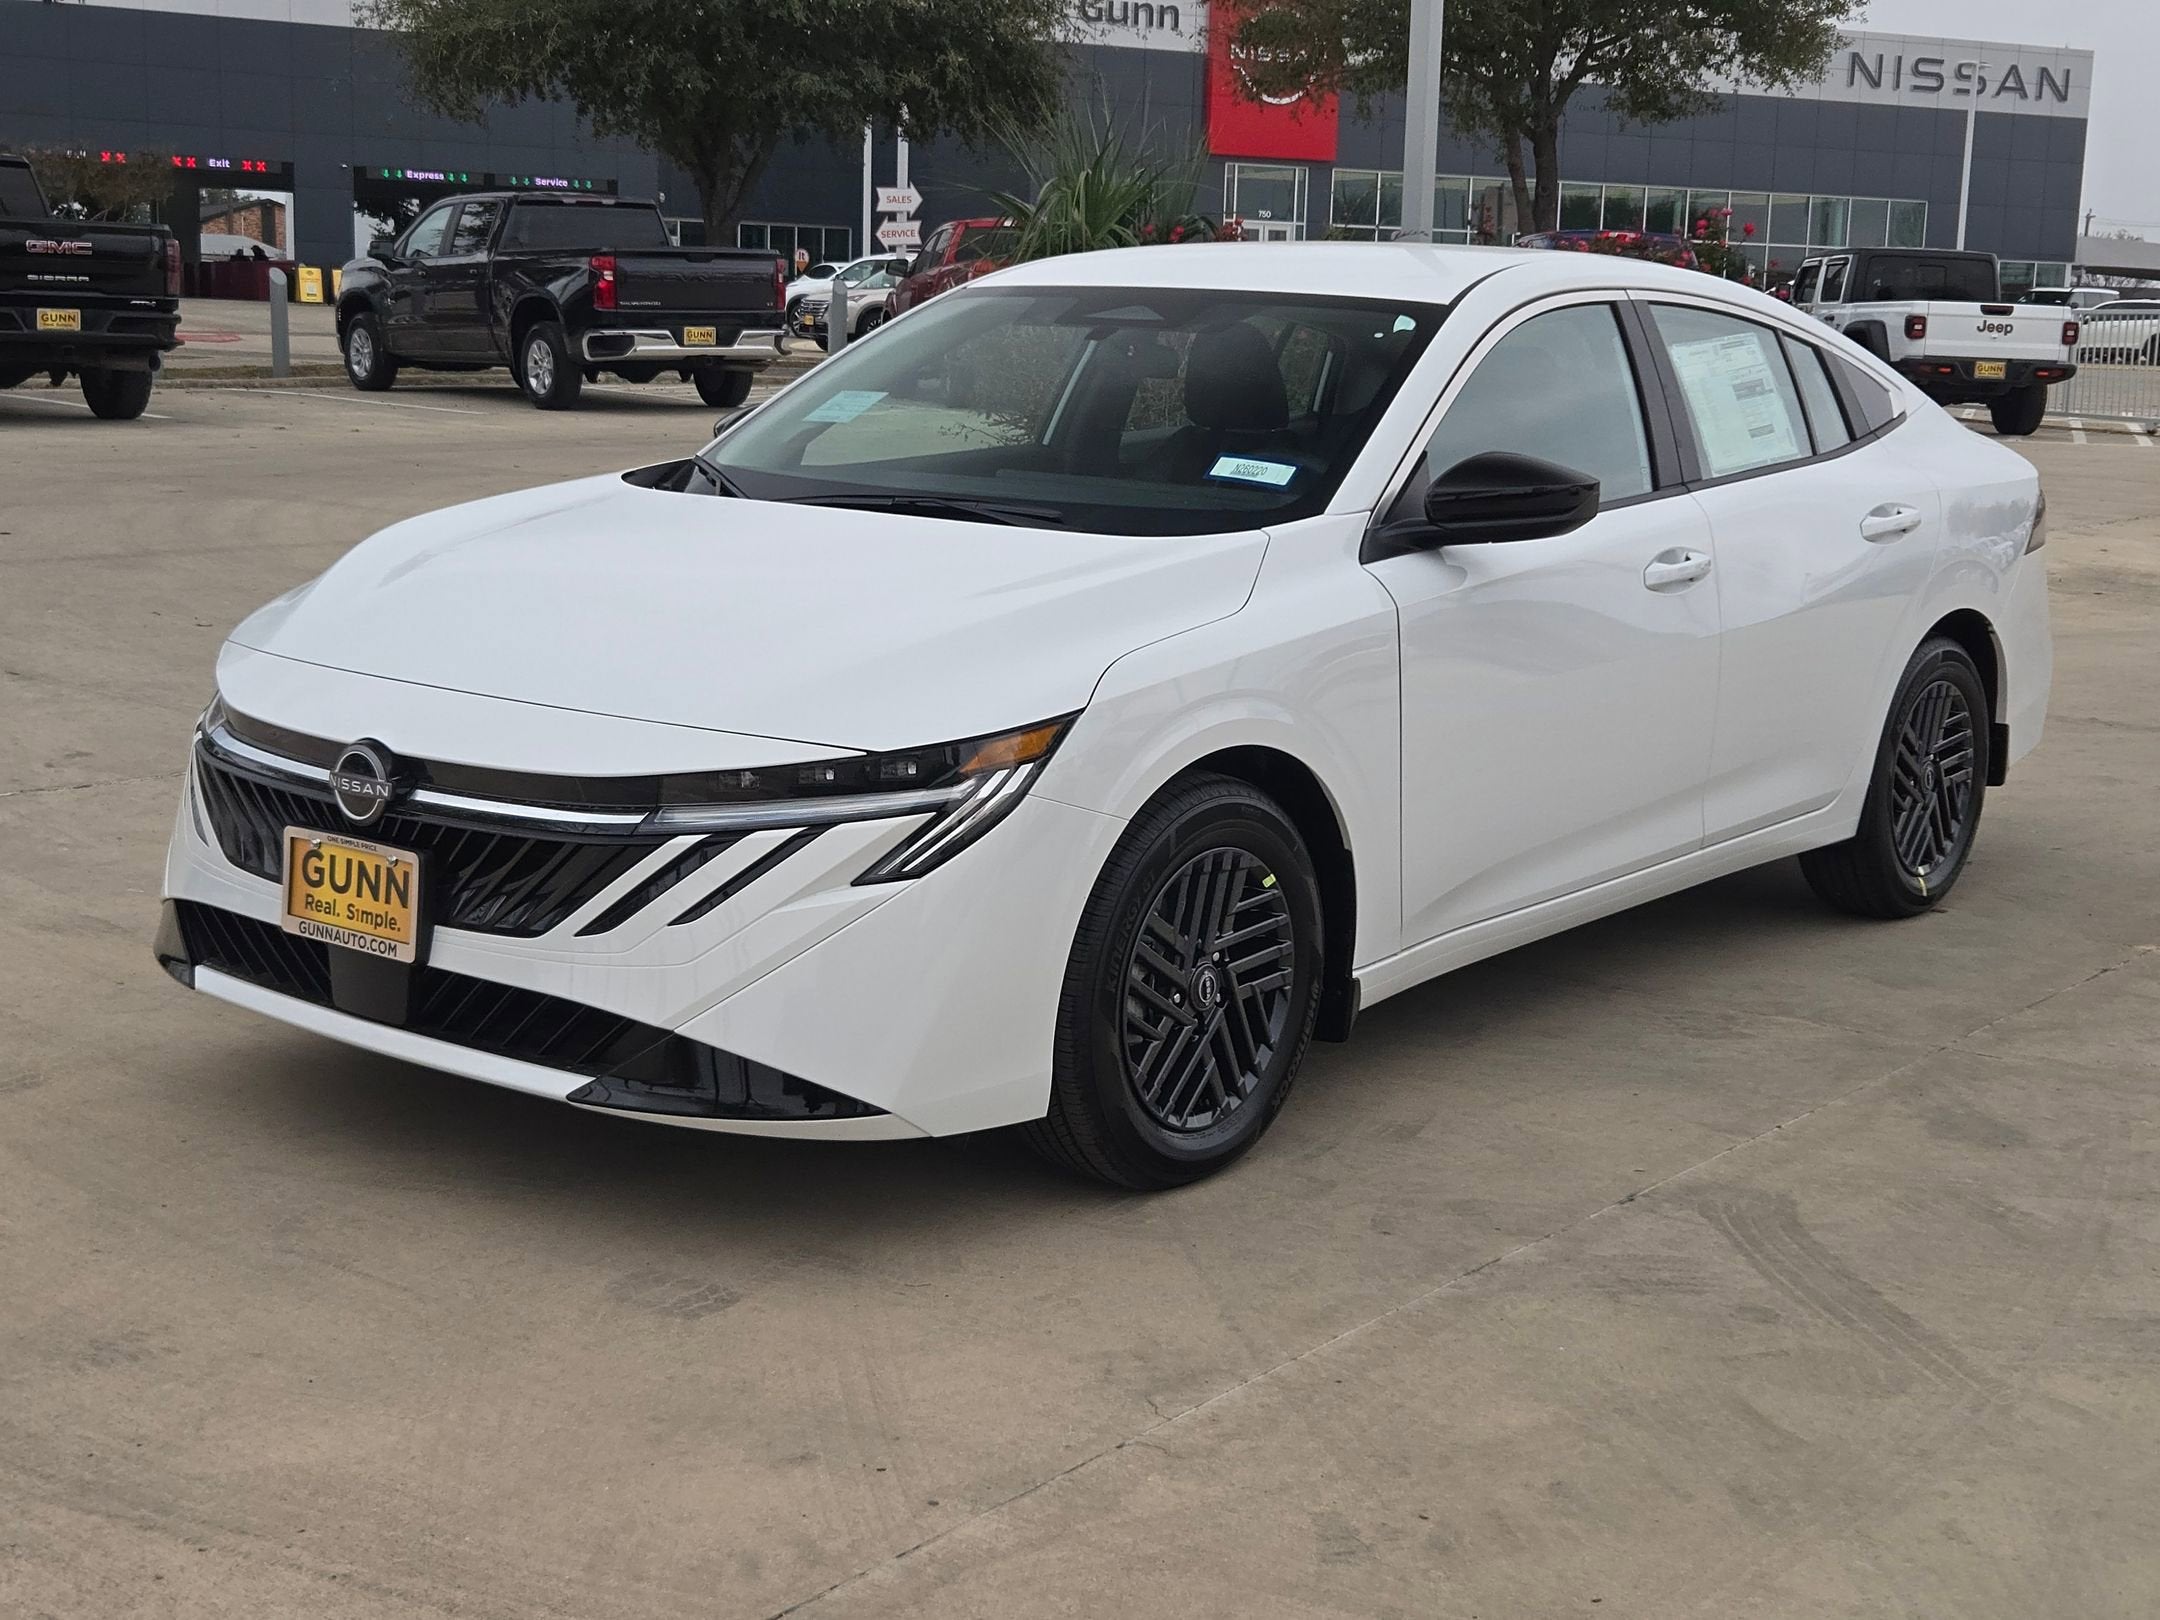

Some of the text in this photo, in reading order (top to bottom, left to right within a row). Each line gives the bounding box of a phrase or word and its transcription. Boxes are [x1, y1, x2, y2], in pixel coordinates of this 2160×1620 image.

[1081, 0, 1180, 30] Gunn
[1846, 51, 2071, 103] NISSAN
[208, 158, 230, 168] Exit
[406, 170, 445, 181] Express
[535, 177, 568, 187] Service
[886, 195, 912, 204] SALES
[1258, 210, 1272, 219] 750
[881, 229, 916, 239] SERVICE
[26, 239, 92, 255] GMC
[41, 313, 76, 323] GUNN
[1977, 319, 2014, 336] Jeep
[687, 330, 712, 339] GUNN
[1977, 364, 2003, 373] GUNN
[329, 774, 389, 798] NISSAN
[302, 850, 409, 909] GUNN
[305, 893, 340, 918] Real.
[298, 920, 398, 958] GUNNAUTO.COM
